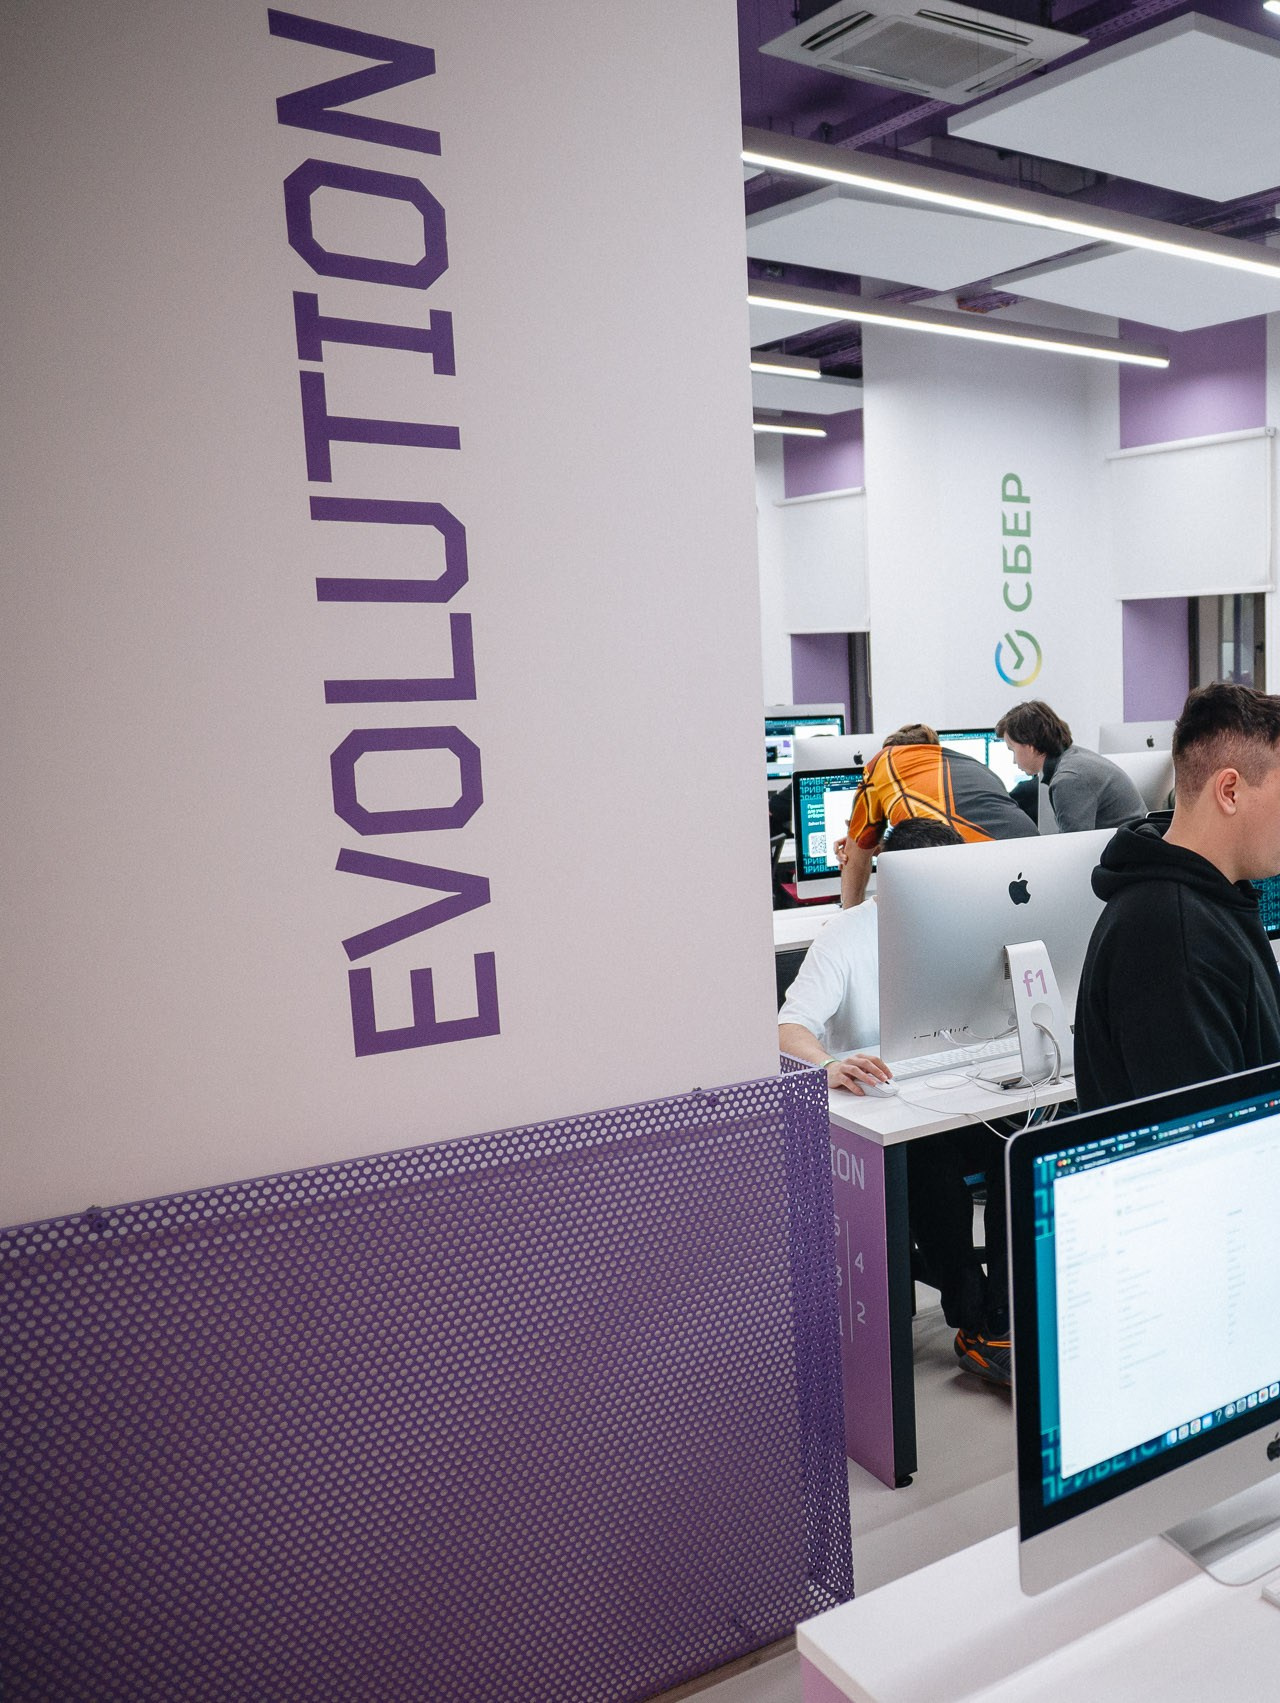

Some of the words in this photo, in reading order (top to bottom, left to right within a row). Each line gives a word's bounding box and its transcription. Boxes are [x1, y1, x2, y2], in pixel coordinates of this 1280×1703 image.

[267, 8, 501, 1057] EVOLUTION
[1001, 472, 1033, 612] СБЕР
[1023, 969, 1047, 997] f1
[854, 1252, 865, 1274] 4
[856, 1301, 866, 1325] 2
